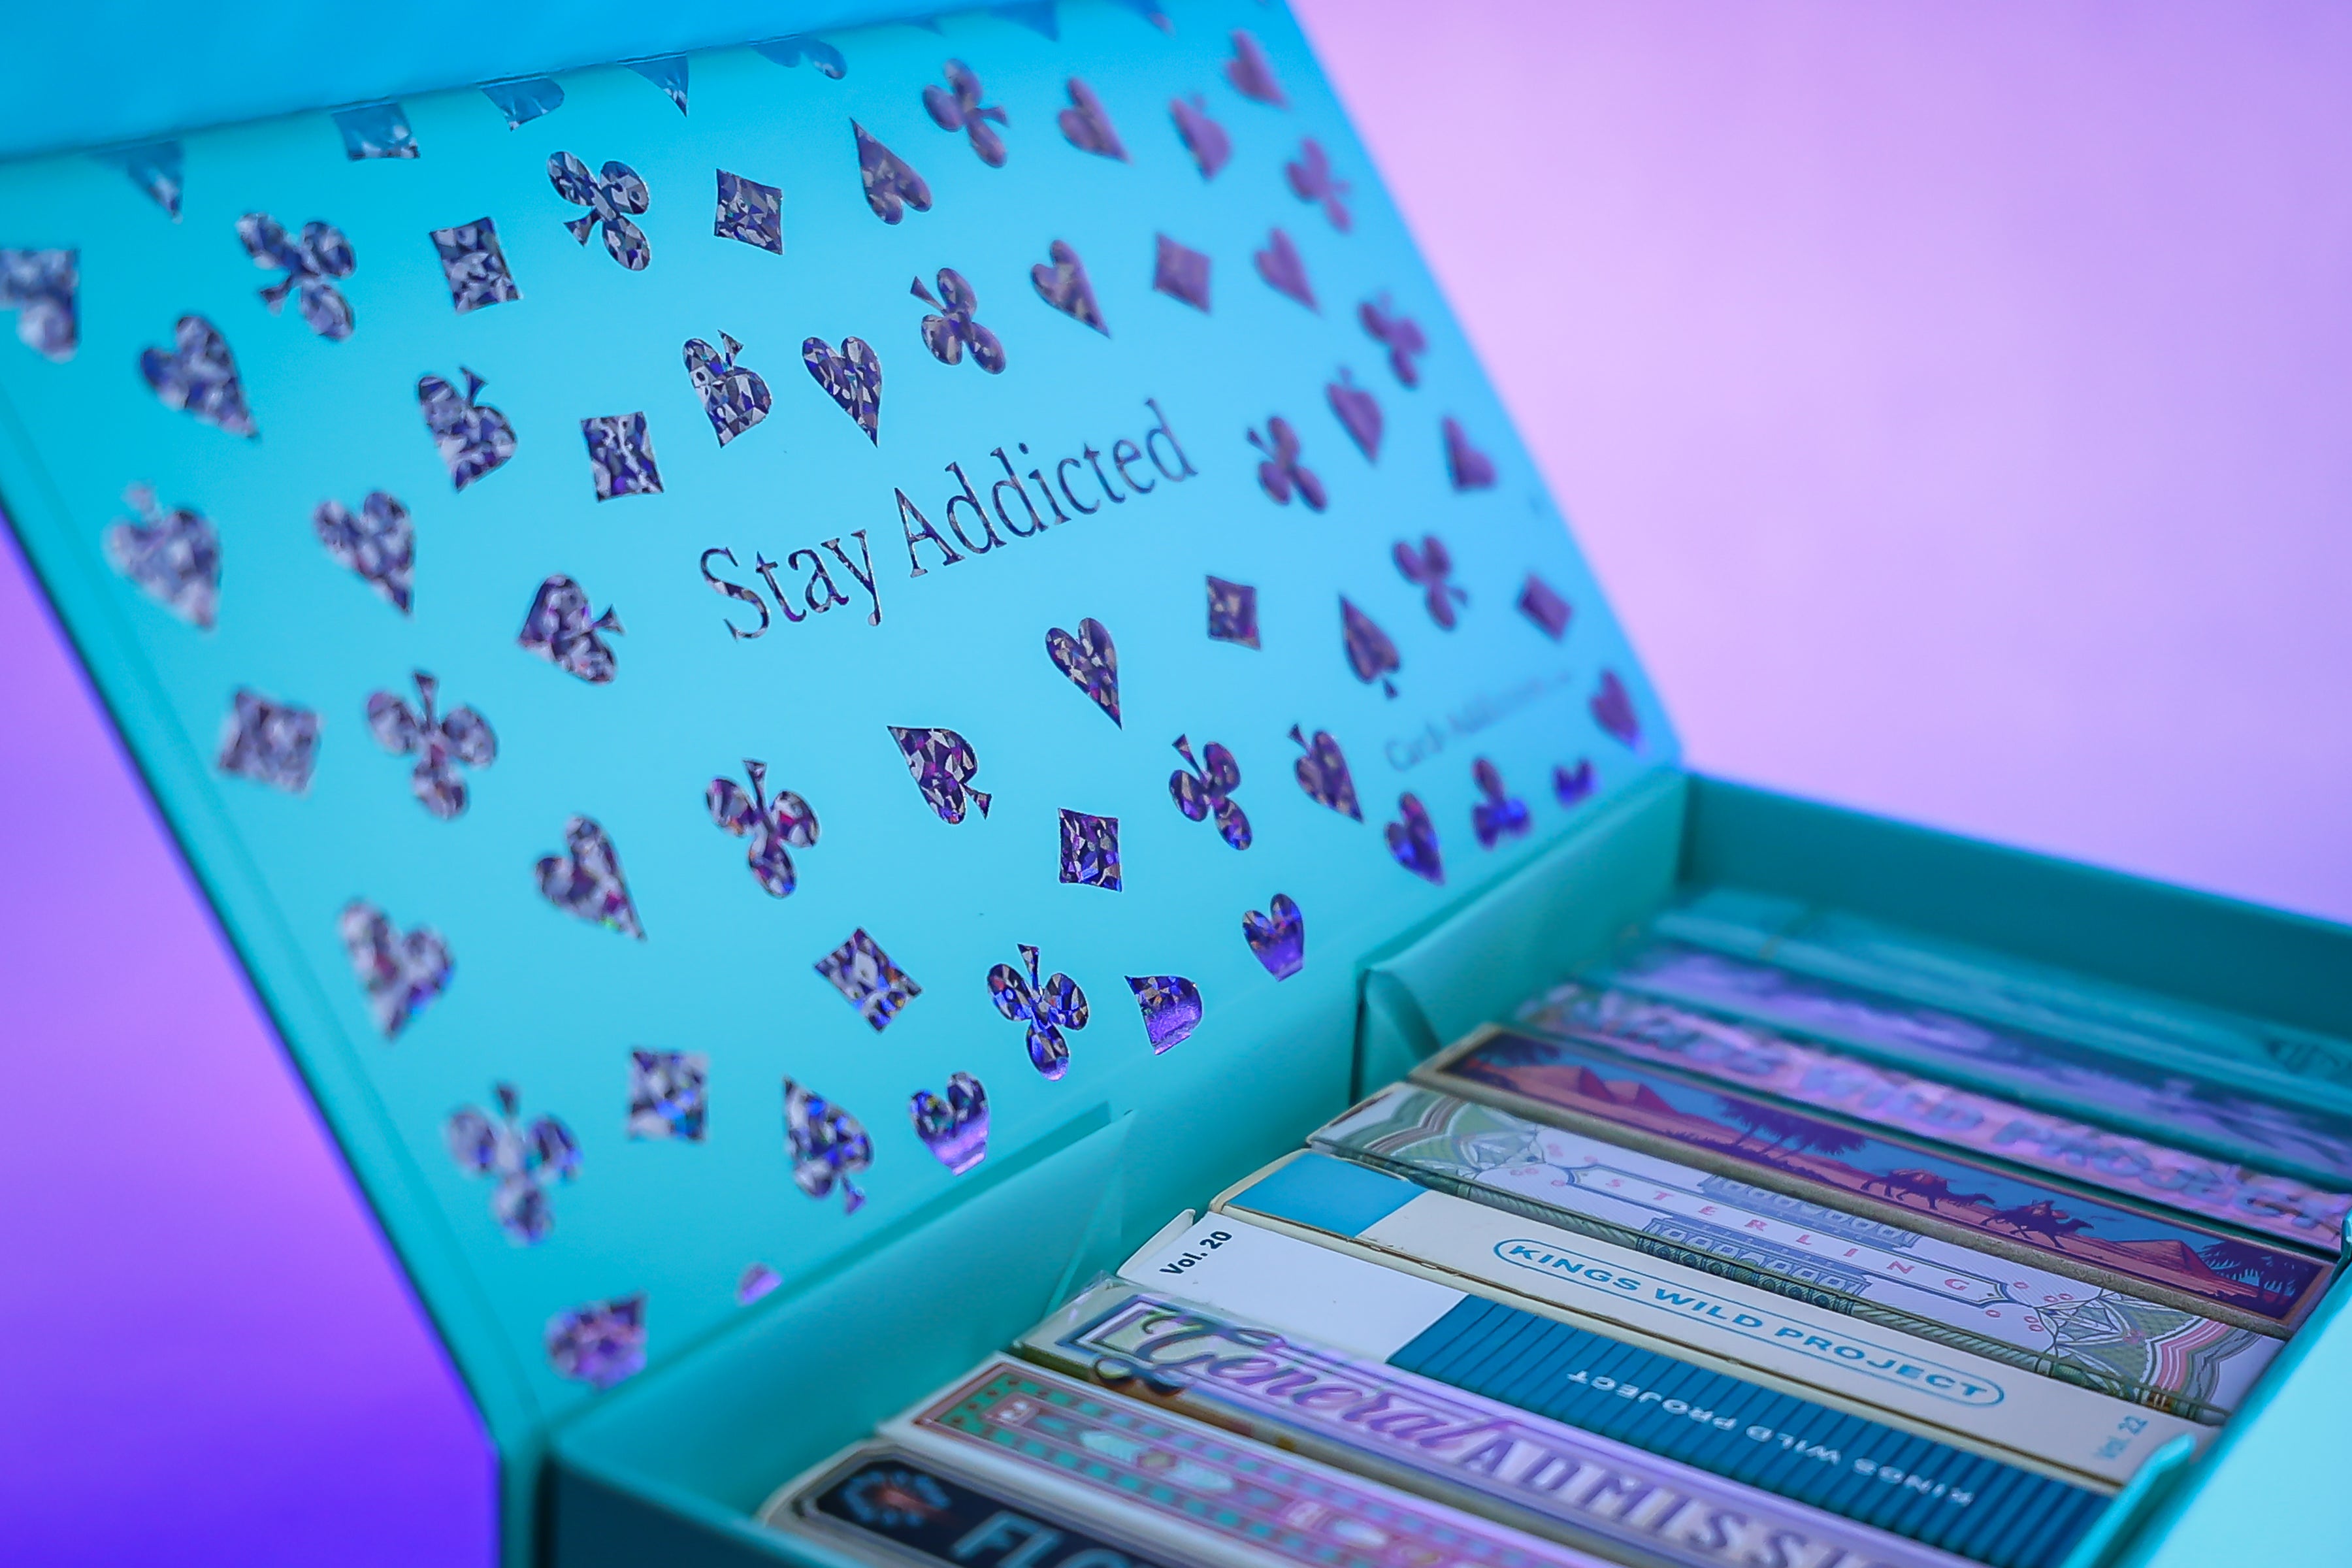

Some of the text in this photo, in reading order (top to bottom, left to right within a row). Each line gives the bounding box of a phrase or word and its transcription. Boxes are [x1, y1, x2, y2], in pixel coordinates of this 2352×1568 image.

[699, 398, 1199, 641] Stay Addicted
[1158, 1230, 1233, 1275] Vol. 20
[1605, 1177, 1970, 1293] STERLING
[1508, 1244, 1989, 1398] KINGS WILD PROJECT
[1094, 1308, 1895, 1568] General ADMISSI
[1567, 1369, 1974, 1507] KINGS WILD PROJECT
